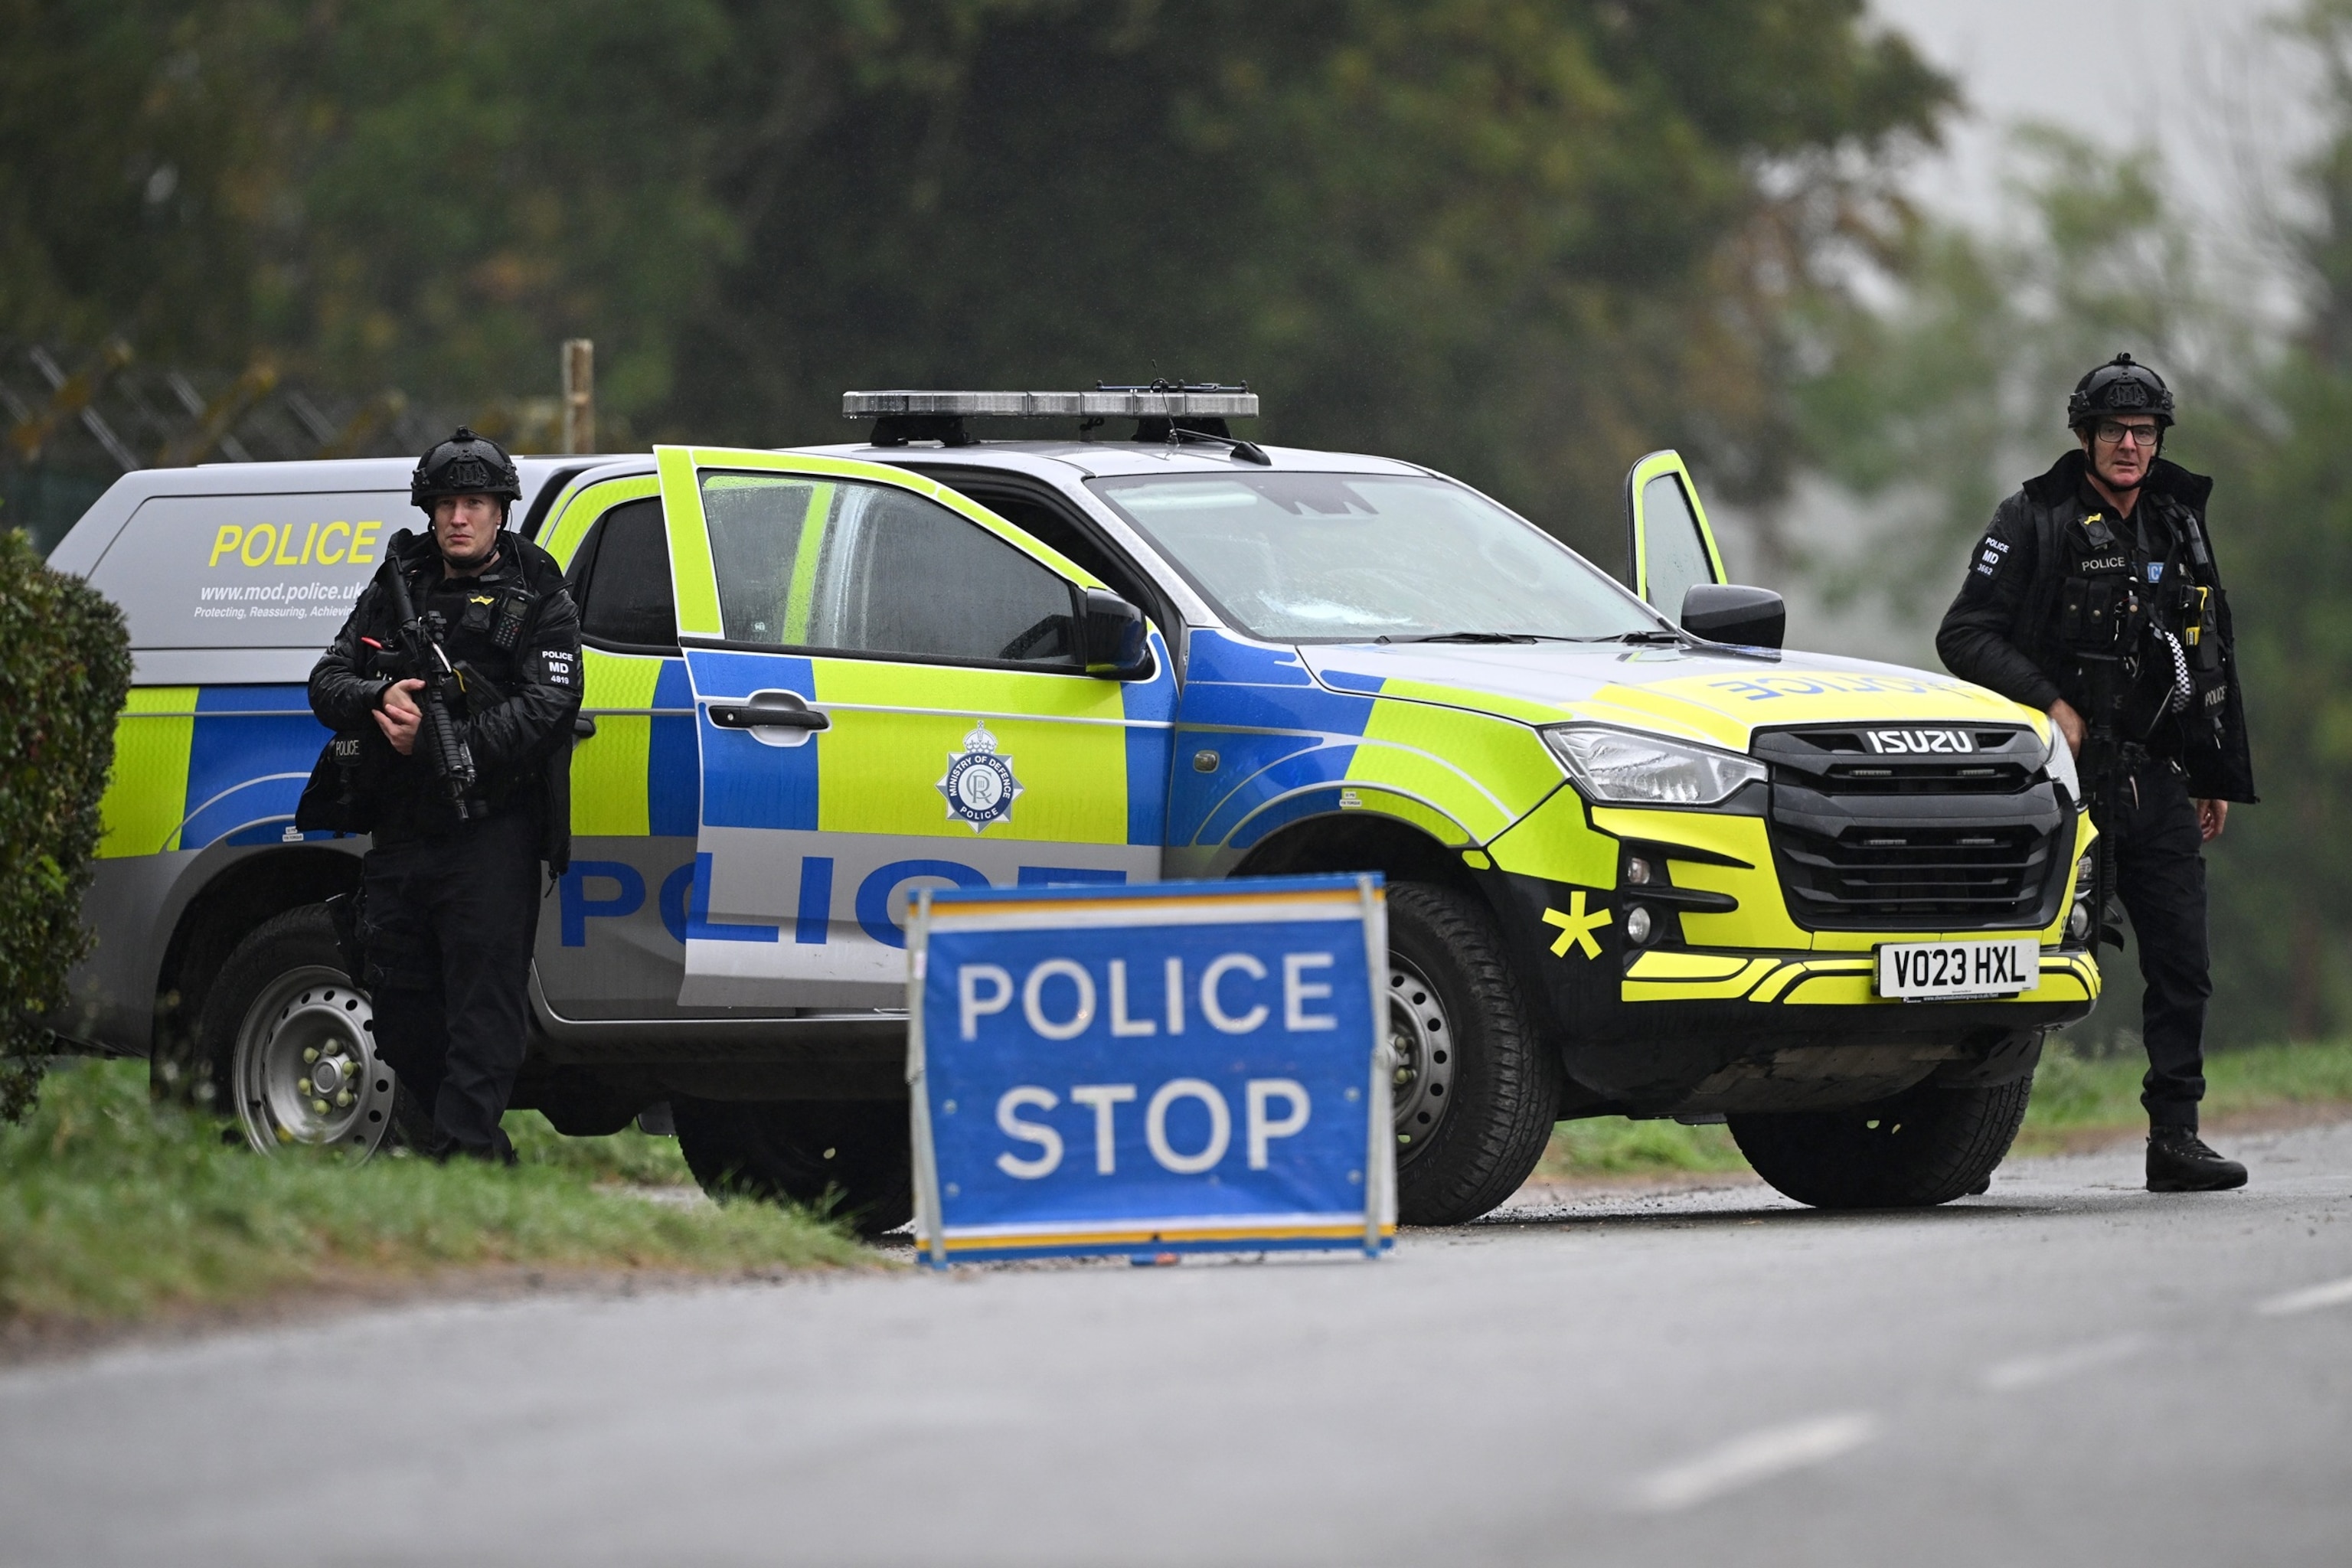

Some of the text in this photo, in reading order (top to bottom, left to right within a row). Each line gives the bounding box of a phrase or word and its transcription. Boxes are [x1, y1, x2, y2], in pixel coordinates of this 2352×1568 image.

[208, 521, 383, 567] POLICE
[1984, 537, 2010, 554] POLICE
[1981, 549, 1999, 564] MD
[2082, 557, 2125, 571] POLICE
[194, 604, 357, 620] Protecting, Reassuring, Achievin
[542, 651, 573, 662] POLICE
[549, 662, 569, 674] MD
[550, 675, 570, 684] 4819
[336, 740, 360, 756] POLICE
[1867, 730, 1973, 754] ISUZU
[949, 755, 1011, 799] MINISTRY OF DEFENCE
[960, 806, 998, 820] POLICE
[560, 852, 1127, 951] PLIC
[1975, 946, 2027, 985] HXL
[958, 952, 1338, 1041] POLICE
[996, 1078, 1312, 1180] STOP
